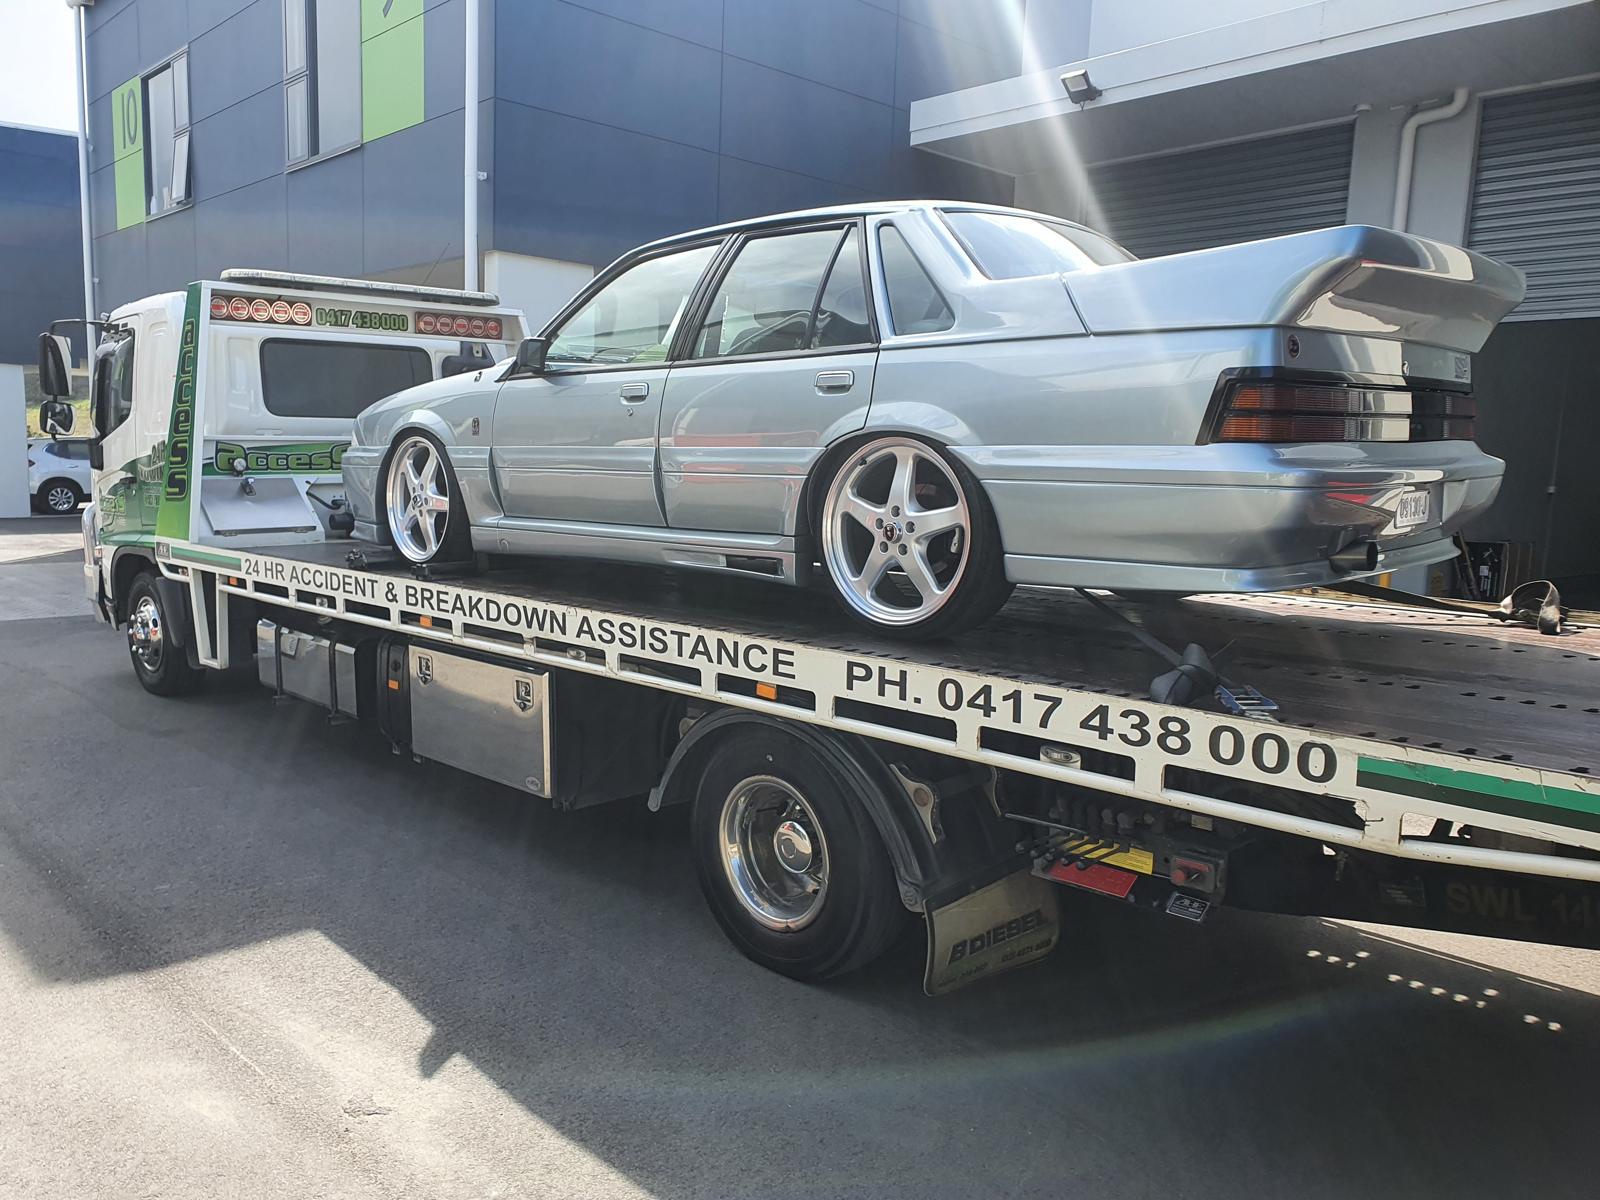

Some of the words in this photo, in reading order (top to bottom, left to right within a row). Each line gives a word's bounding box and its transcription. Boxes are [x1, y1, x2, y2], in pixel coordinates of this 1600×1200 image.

[120, 87, 138, 150] 10
[315, 307, 352, 329] 0417
[244, 558, 261, 577] 24
[264, 561, 286, 581] HR
[289, 565, 379, 599] ACCIDENT
[385, 581, 399, 604] &
[405, 585, 567, 636] BREAKDOWN
[575, 615, 797, 680] ASSISTANCE
[845, 660, 922, 705] PH.
[937, 677, 1063, 729] 0417
[1079, 704, 1192, 756] 438
[1208, 725, 1338, 783] 000
